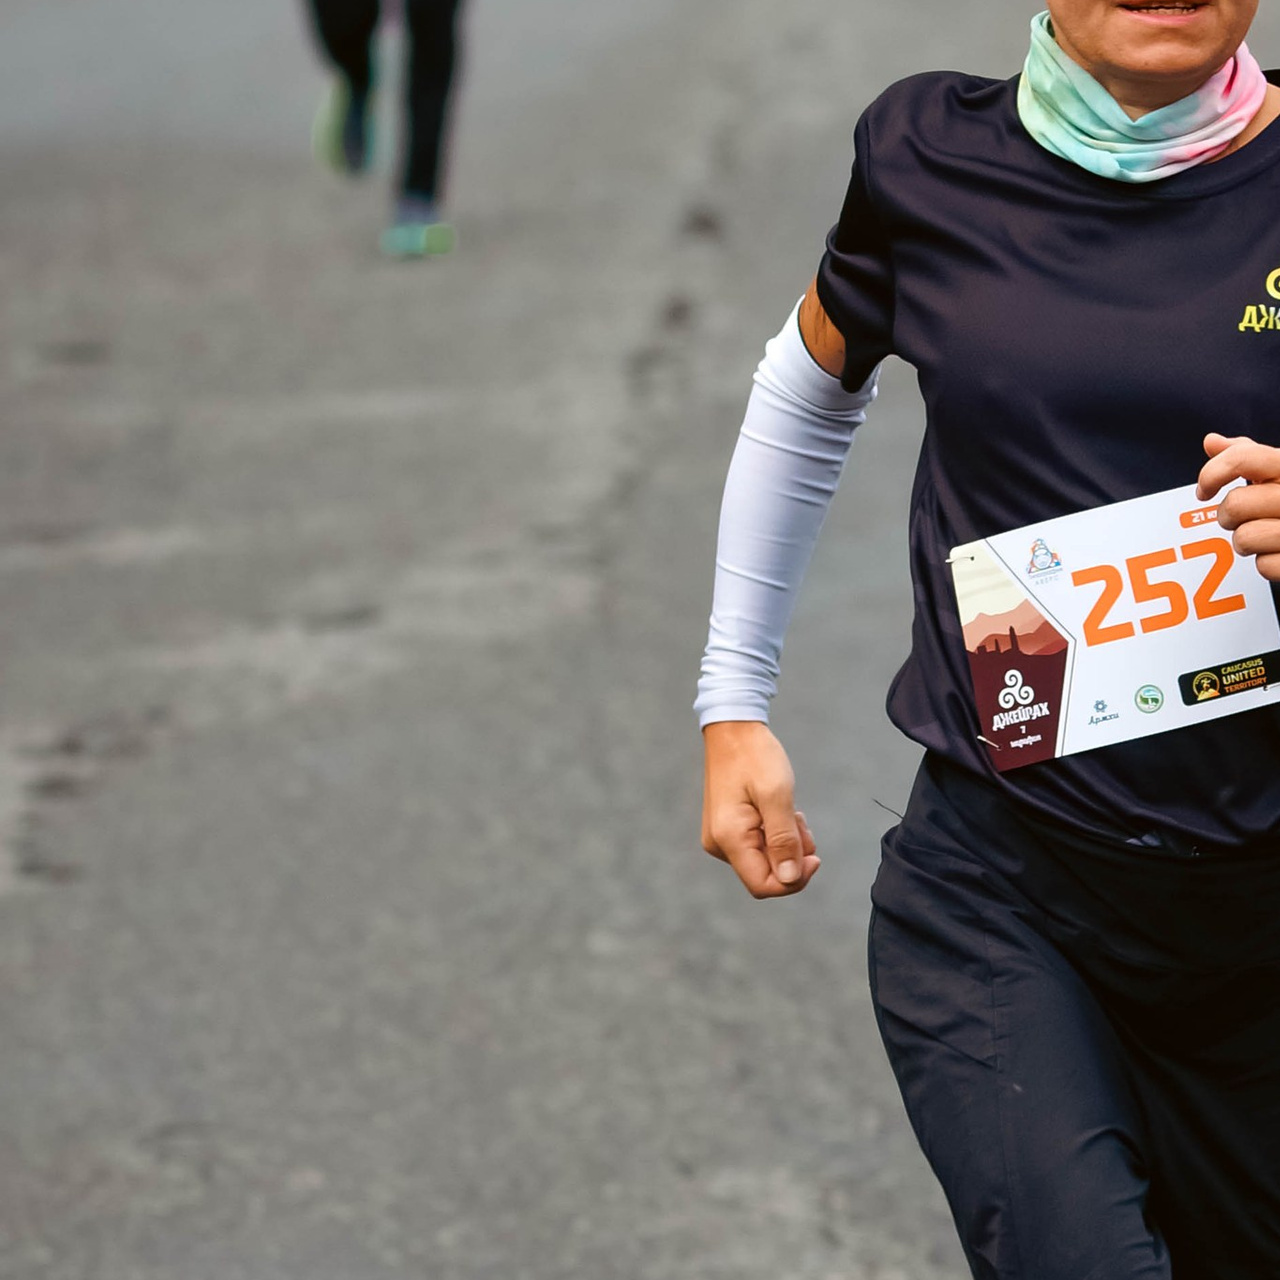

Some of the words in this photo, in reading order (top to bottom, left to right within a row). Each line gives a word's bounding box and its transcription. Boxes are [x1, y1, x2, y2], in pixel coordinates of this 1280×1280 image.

[1191, 511, 1205, 523] 21
[1071, 537, 1246, 647] 252
[1221, 658, 1263, 675] CAUCASUS
[1222, 666, 1266, 685] UNITED
[1224, 676, 1268, 693] TERRITORY
[992, 701, 1050, 732] ДЖЕЙРАХ
